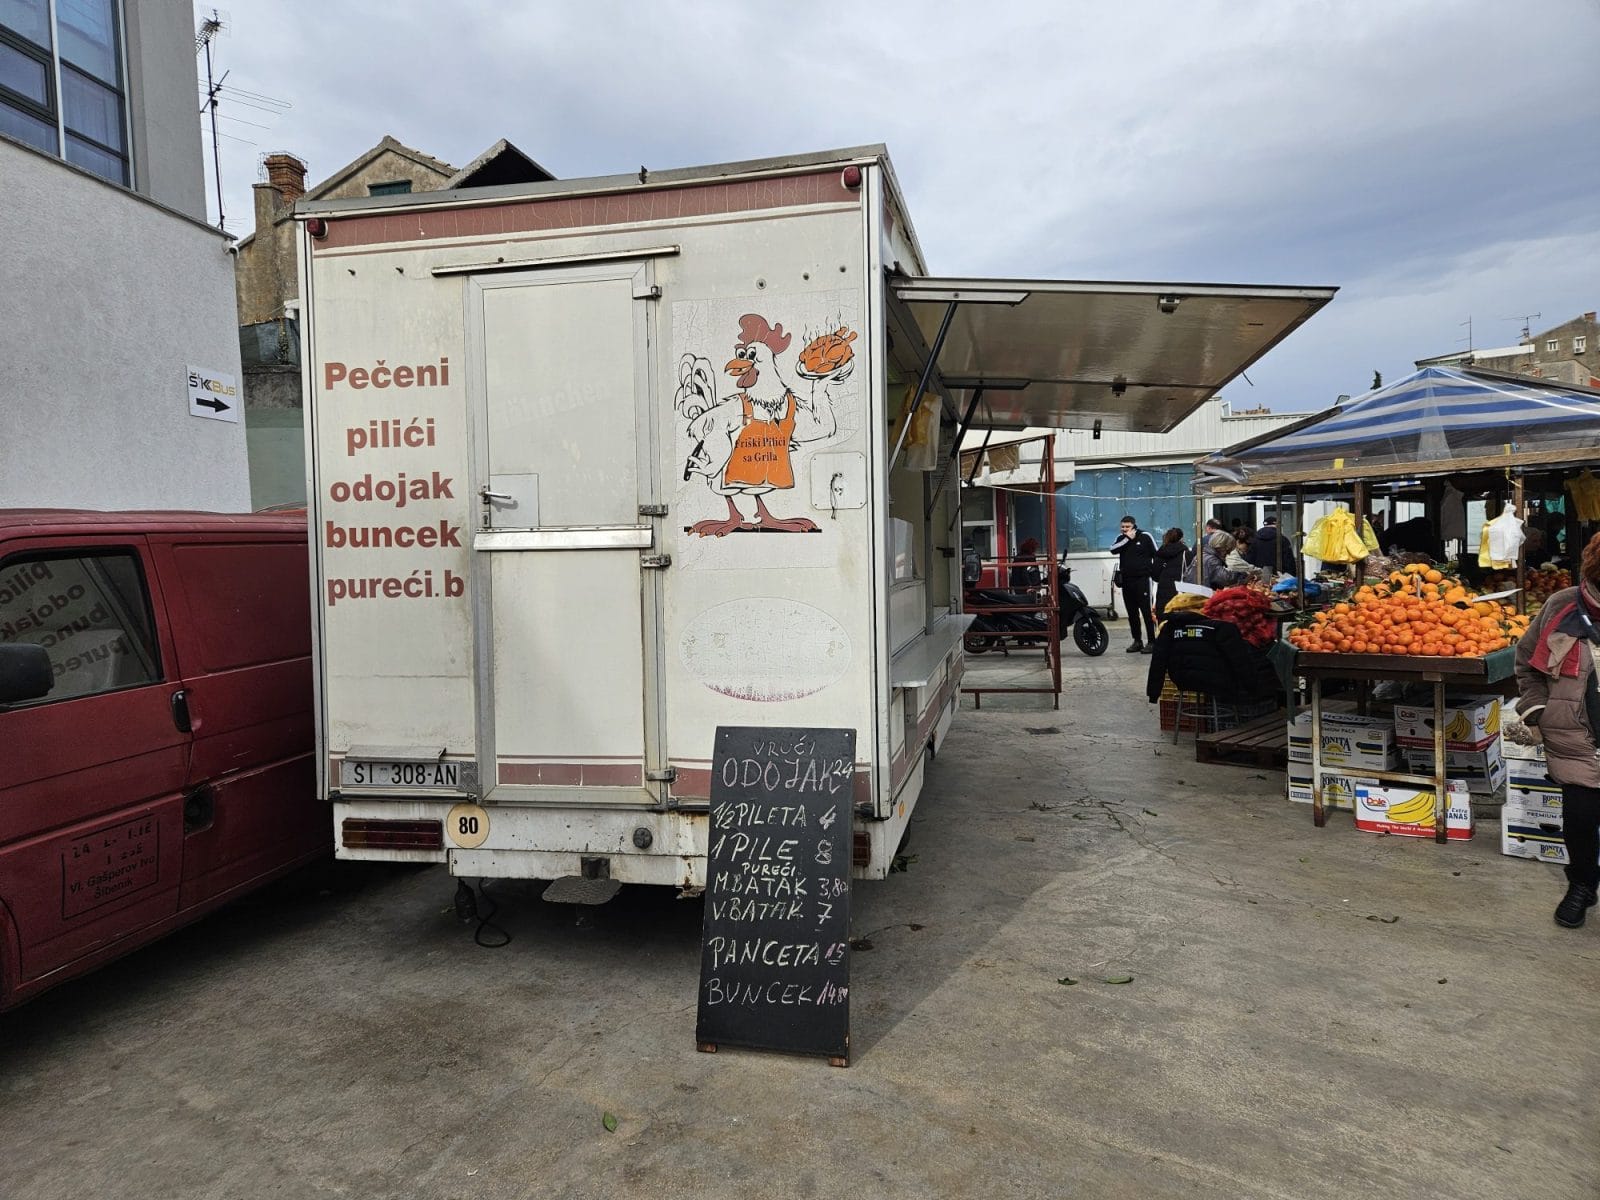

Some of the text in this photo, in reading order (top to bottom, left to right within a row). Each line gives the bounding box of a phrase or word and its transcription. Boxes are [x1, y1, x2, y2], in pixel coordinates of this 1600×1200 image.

[324, 357, 449, 390] Pečeni
[346, 417, 436, 457] pilići
[742, 452, 778, 463] sa Grila
[330, 471, 454, 508] odojak
[326, 519, 462, 548] buncek
[391, 764, 457, 785] 308-AN
[722, 757, 853, 794] ODOJAK 24
[1321, 776, 1352, 792] ONITA
[459, 816, 479, 835] 80
[735, 802, 807, 827] PILETA
[711, 834, 726, 860] 1
[730, 832, 798, 862] PILE
[741, 862, 796, 877] PUREĆI
[817, 901, 833, 924] 7
[708, 936, 819, 970] PANCETA
[705, 978, 812, 1006] BUNCEK
